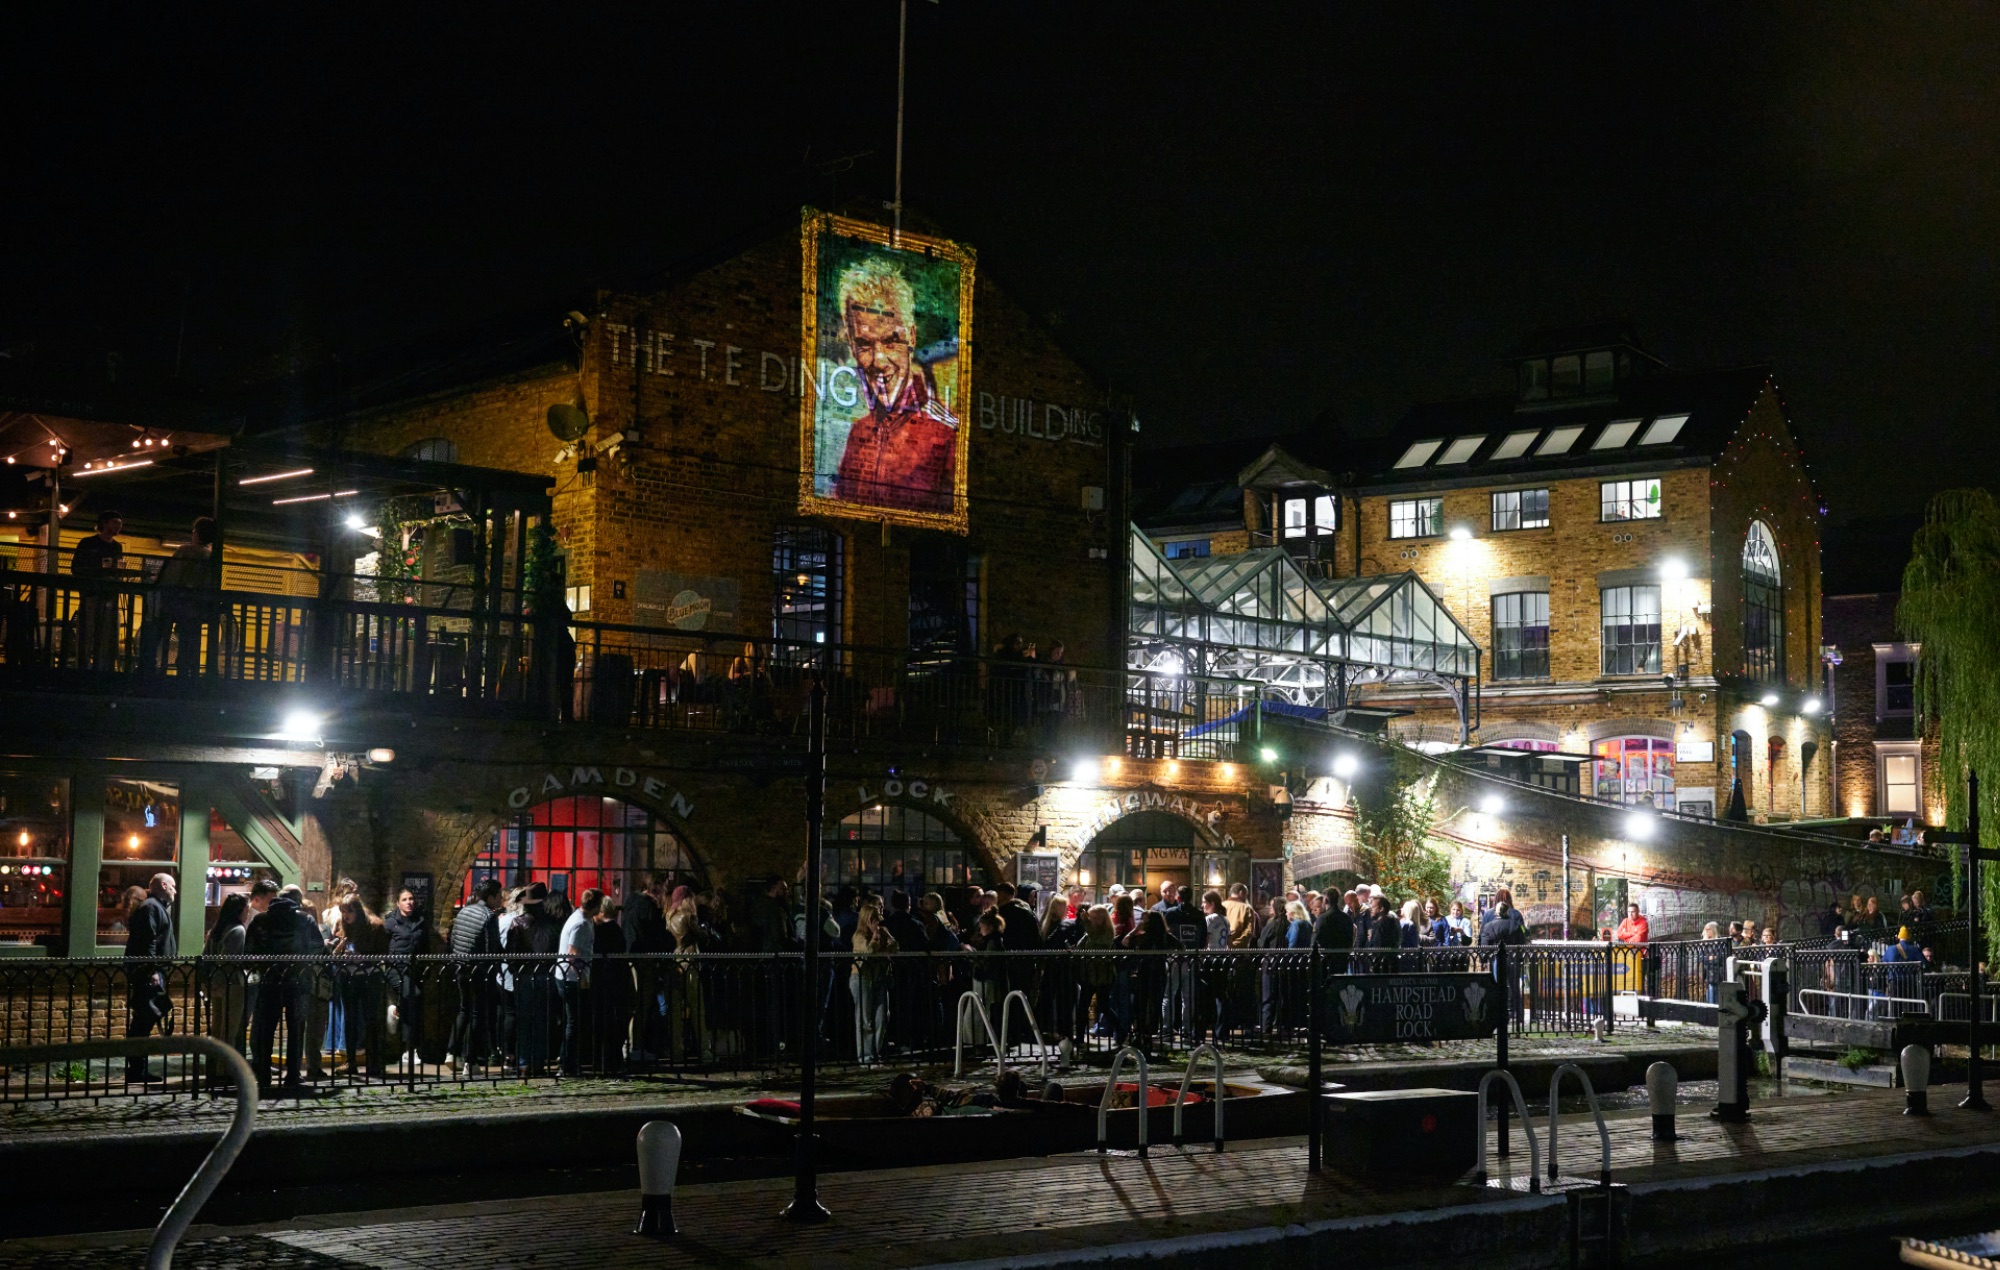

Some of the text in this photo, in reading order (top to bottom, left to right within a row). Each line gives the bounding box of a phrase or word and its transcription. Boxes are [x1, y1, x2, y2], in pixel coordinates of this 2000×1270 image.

[606, 322, 676, 377] THE
[978, 390, 1104, 447] BUILDING
[667, 599, 711, 621] BLUE MOON
[508, 766, 695, 820] CAMDEN
[857, 779, 956, 808] LOCK
[1371, 986, 1456, 1004] HAMPSTEAD
[1396, 1003, 1433, 1021] ROAD
[1396, 1020, 1433, 1038] LOCK
